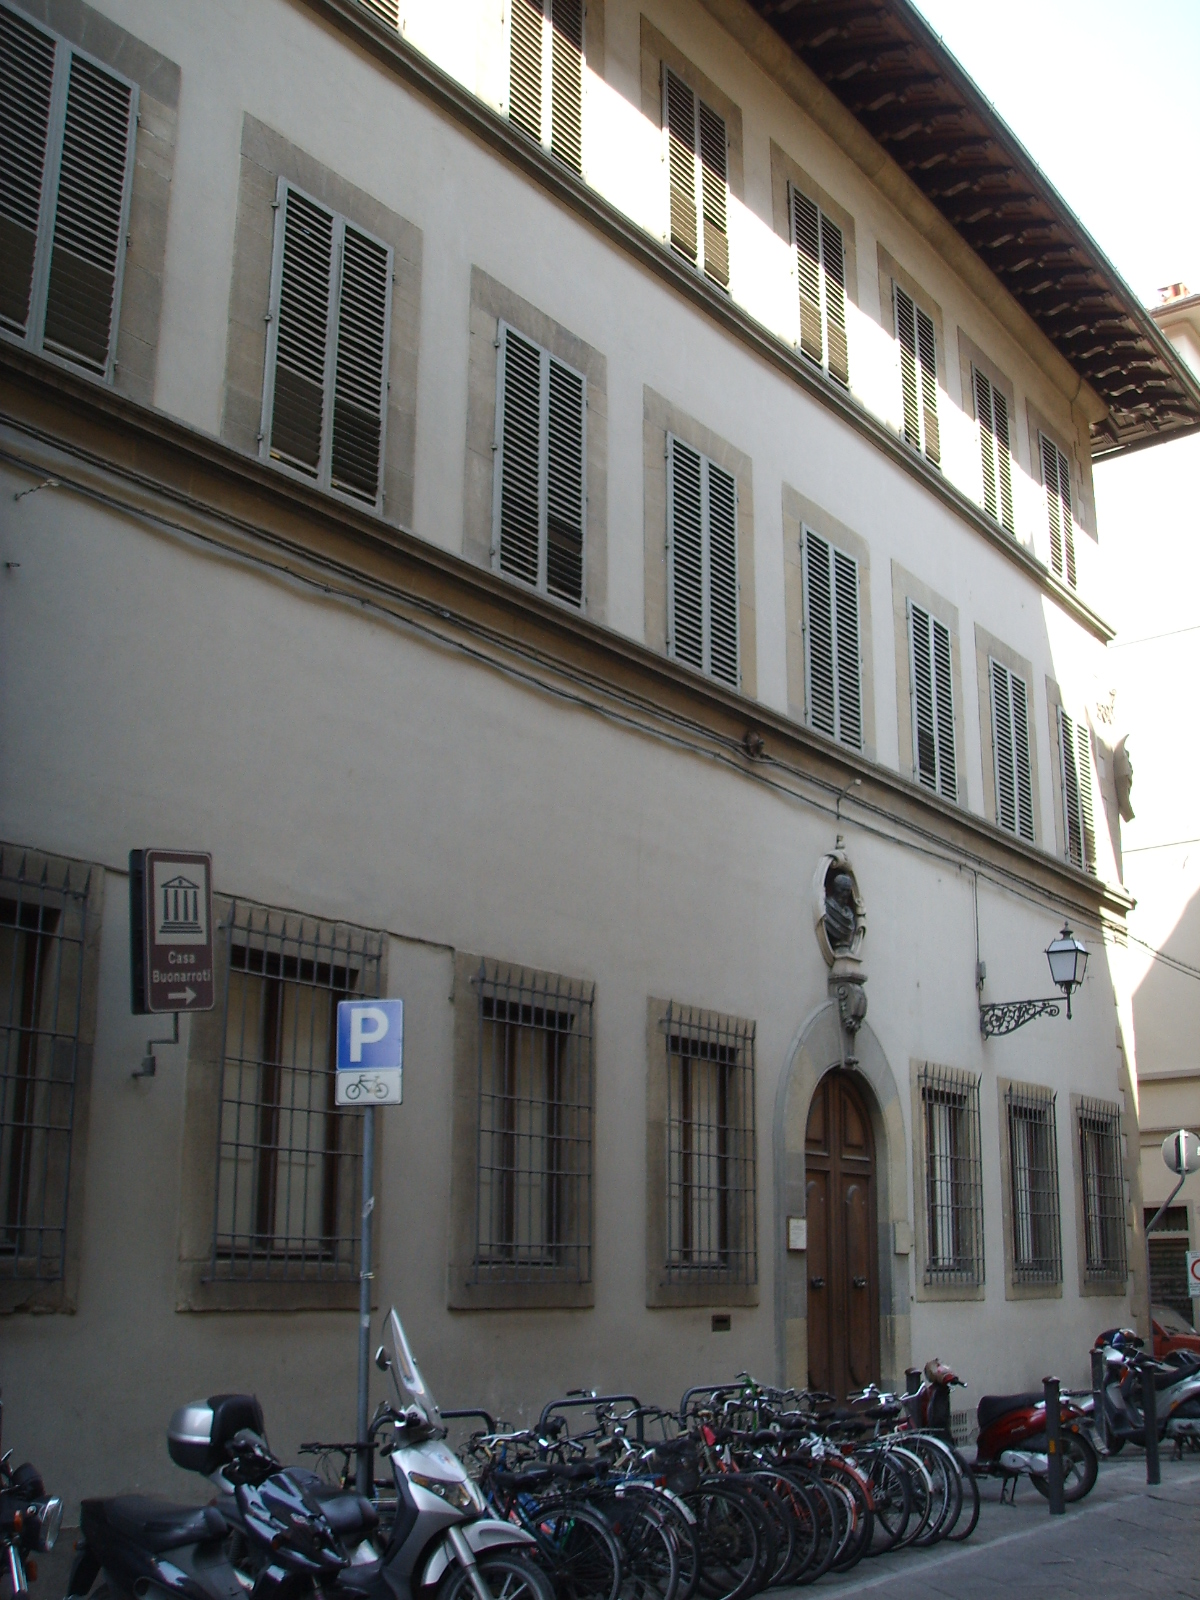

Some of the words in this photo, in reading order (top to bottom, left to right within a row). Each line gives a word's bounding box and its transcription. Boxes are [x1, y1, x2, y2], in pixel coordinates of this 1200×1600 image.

[168, 951, 196, 964] Casa
[152, 969, 211, 983] Buonarroti
[350, 1007, 389, 1063] P
